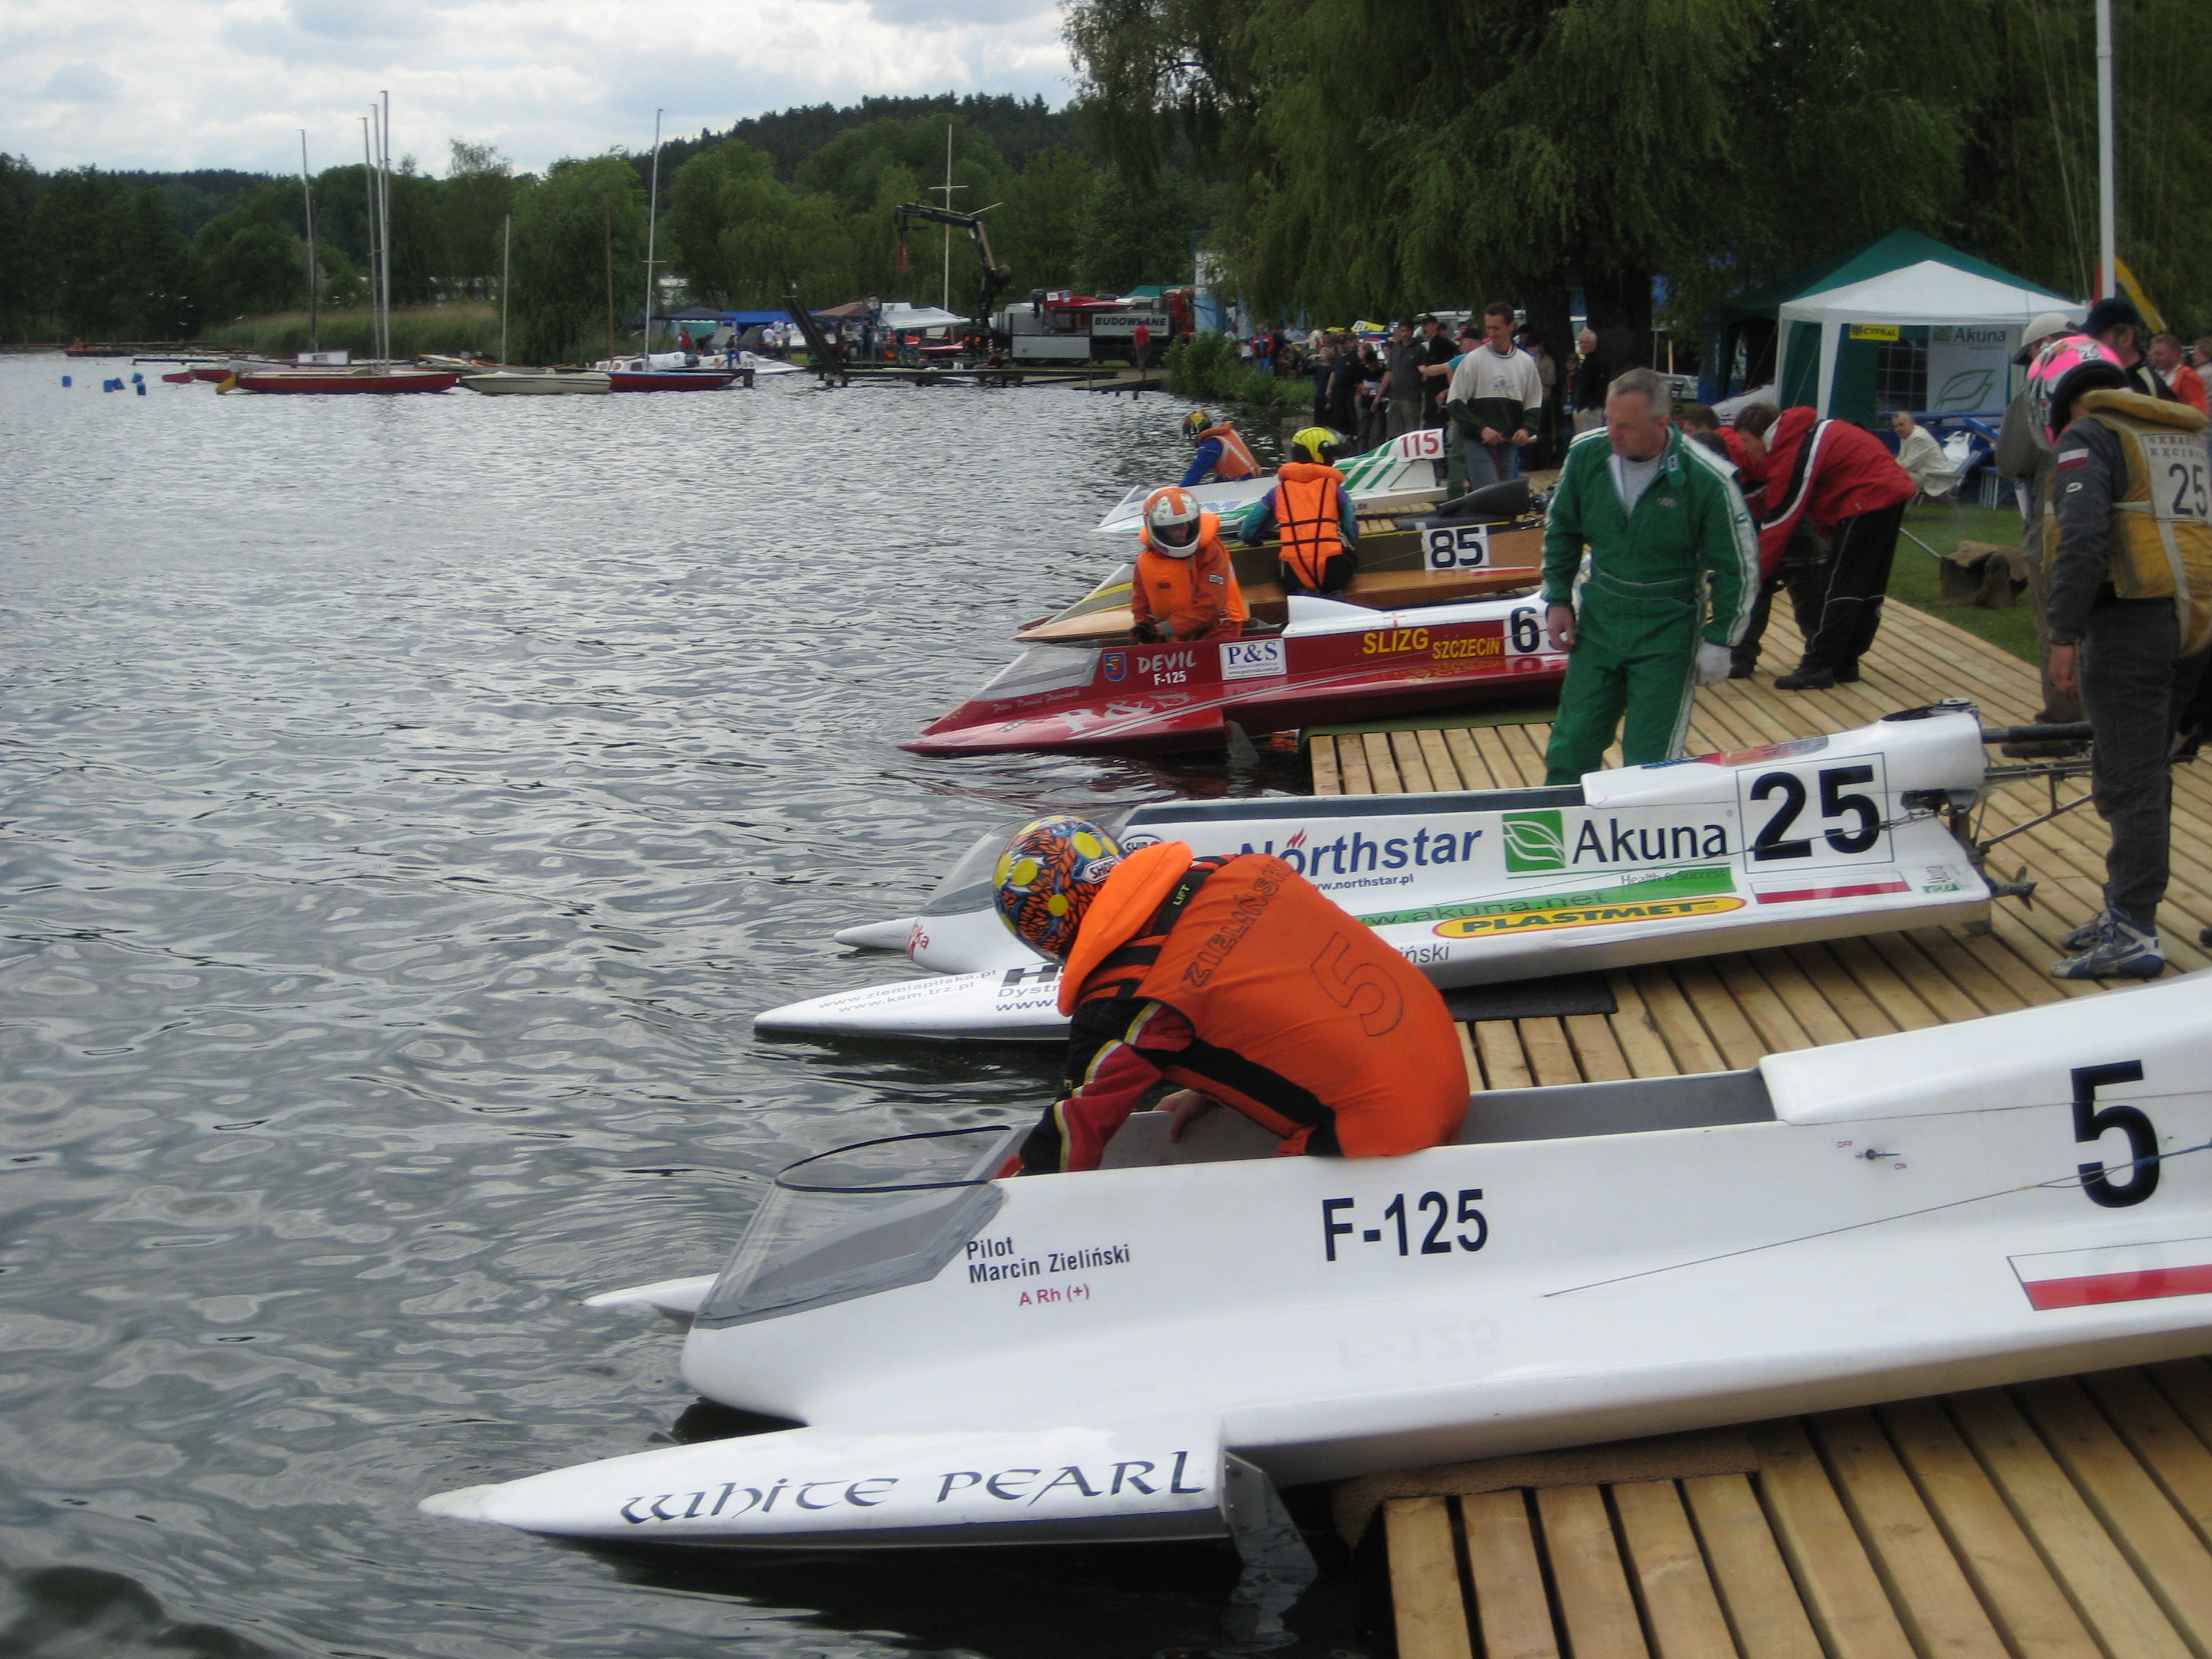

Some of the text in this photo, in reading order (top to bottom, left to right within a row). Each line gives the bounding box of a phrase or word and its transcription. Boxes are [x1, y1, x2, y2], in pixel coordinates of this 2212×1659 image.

[1954, 327, 2006, 343] Akuna
[1401, 431, 1439, 458] 115
[2169, 463, 2208, 517] 25
[1430, 526, 1483, 568] 85
[1362, 628, 1429, 655] SLIZG
[1510, 606, 1561, 654] 6
[1137, 650, 1197, 674] DEVIL
[1226, 641, 1277, 665] P&S
[1154, 670, 1187, 685] F-125
[1750, 763, 1881, 861] 25
[1572, 818, 1727, 864] Akuna
[1620, 872, 1660, 885] Health
[1172, 884, 1190, 907] LIFT
[1462, 899, 1717, 933] PLASTMET
[818, 969, 997, 1009] www.ziemiapilska.pl
[838, 981, 974, 1012] www.ksm.trz.pl
[1310, 931, 1404, 1037] 5
[1837, 1140, 1853, 1148] OFF
[2070, 1059, 2159, 1208] 5
[1322, 1188, 1489, 1262] F-125
[966, 1236, 1015, 1260] Pilot
[968, 1244, 1130, 1284] Marcin Zieliński
[1019, 1283, 1090, 1306] A Rh (+)
[935, 1450, 1207, 1507] PEARL
